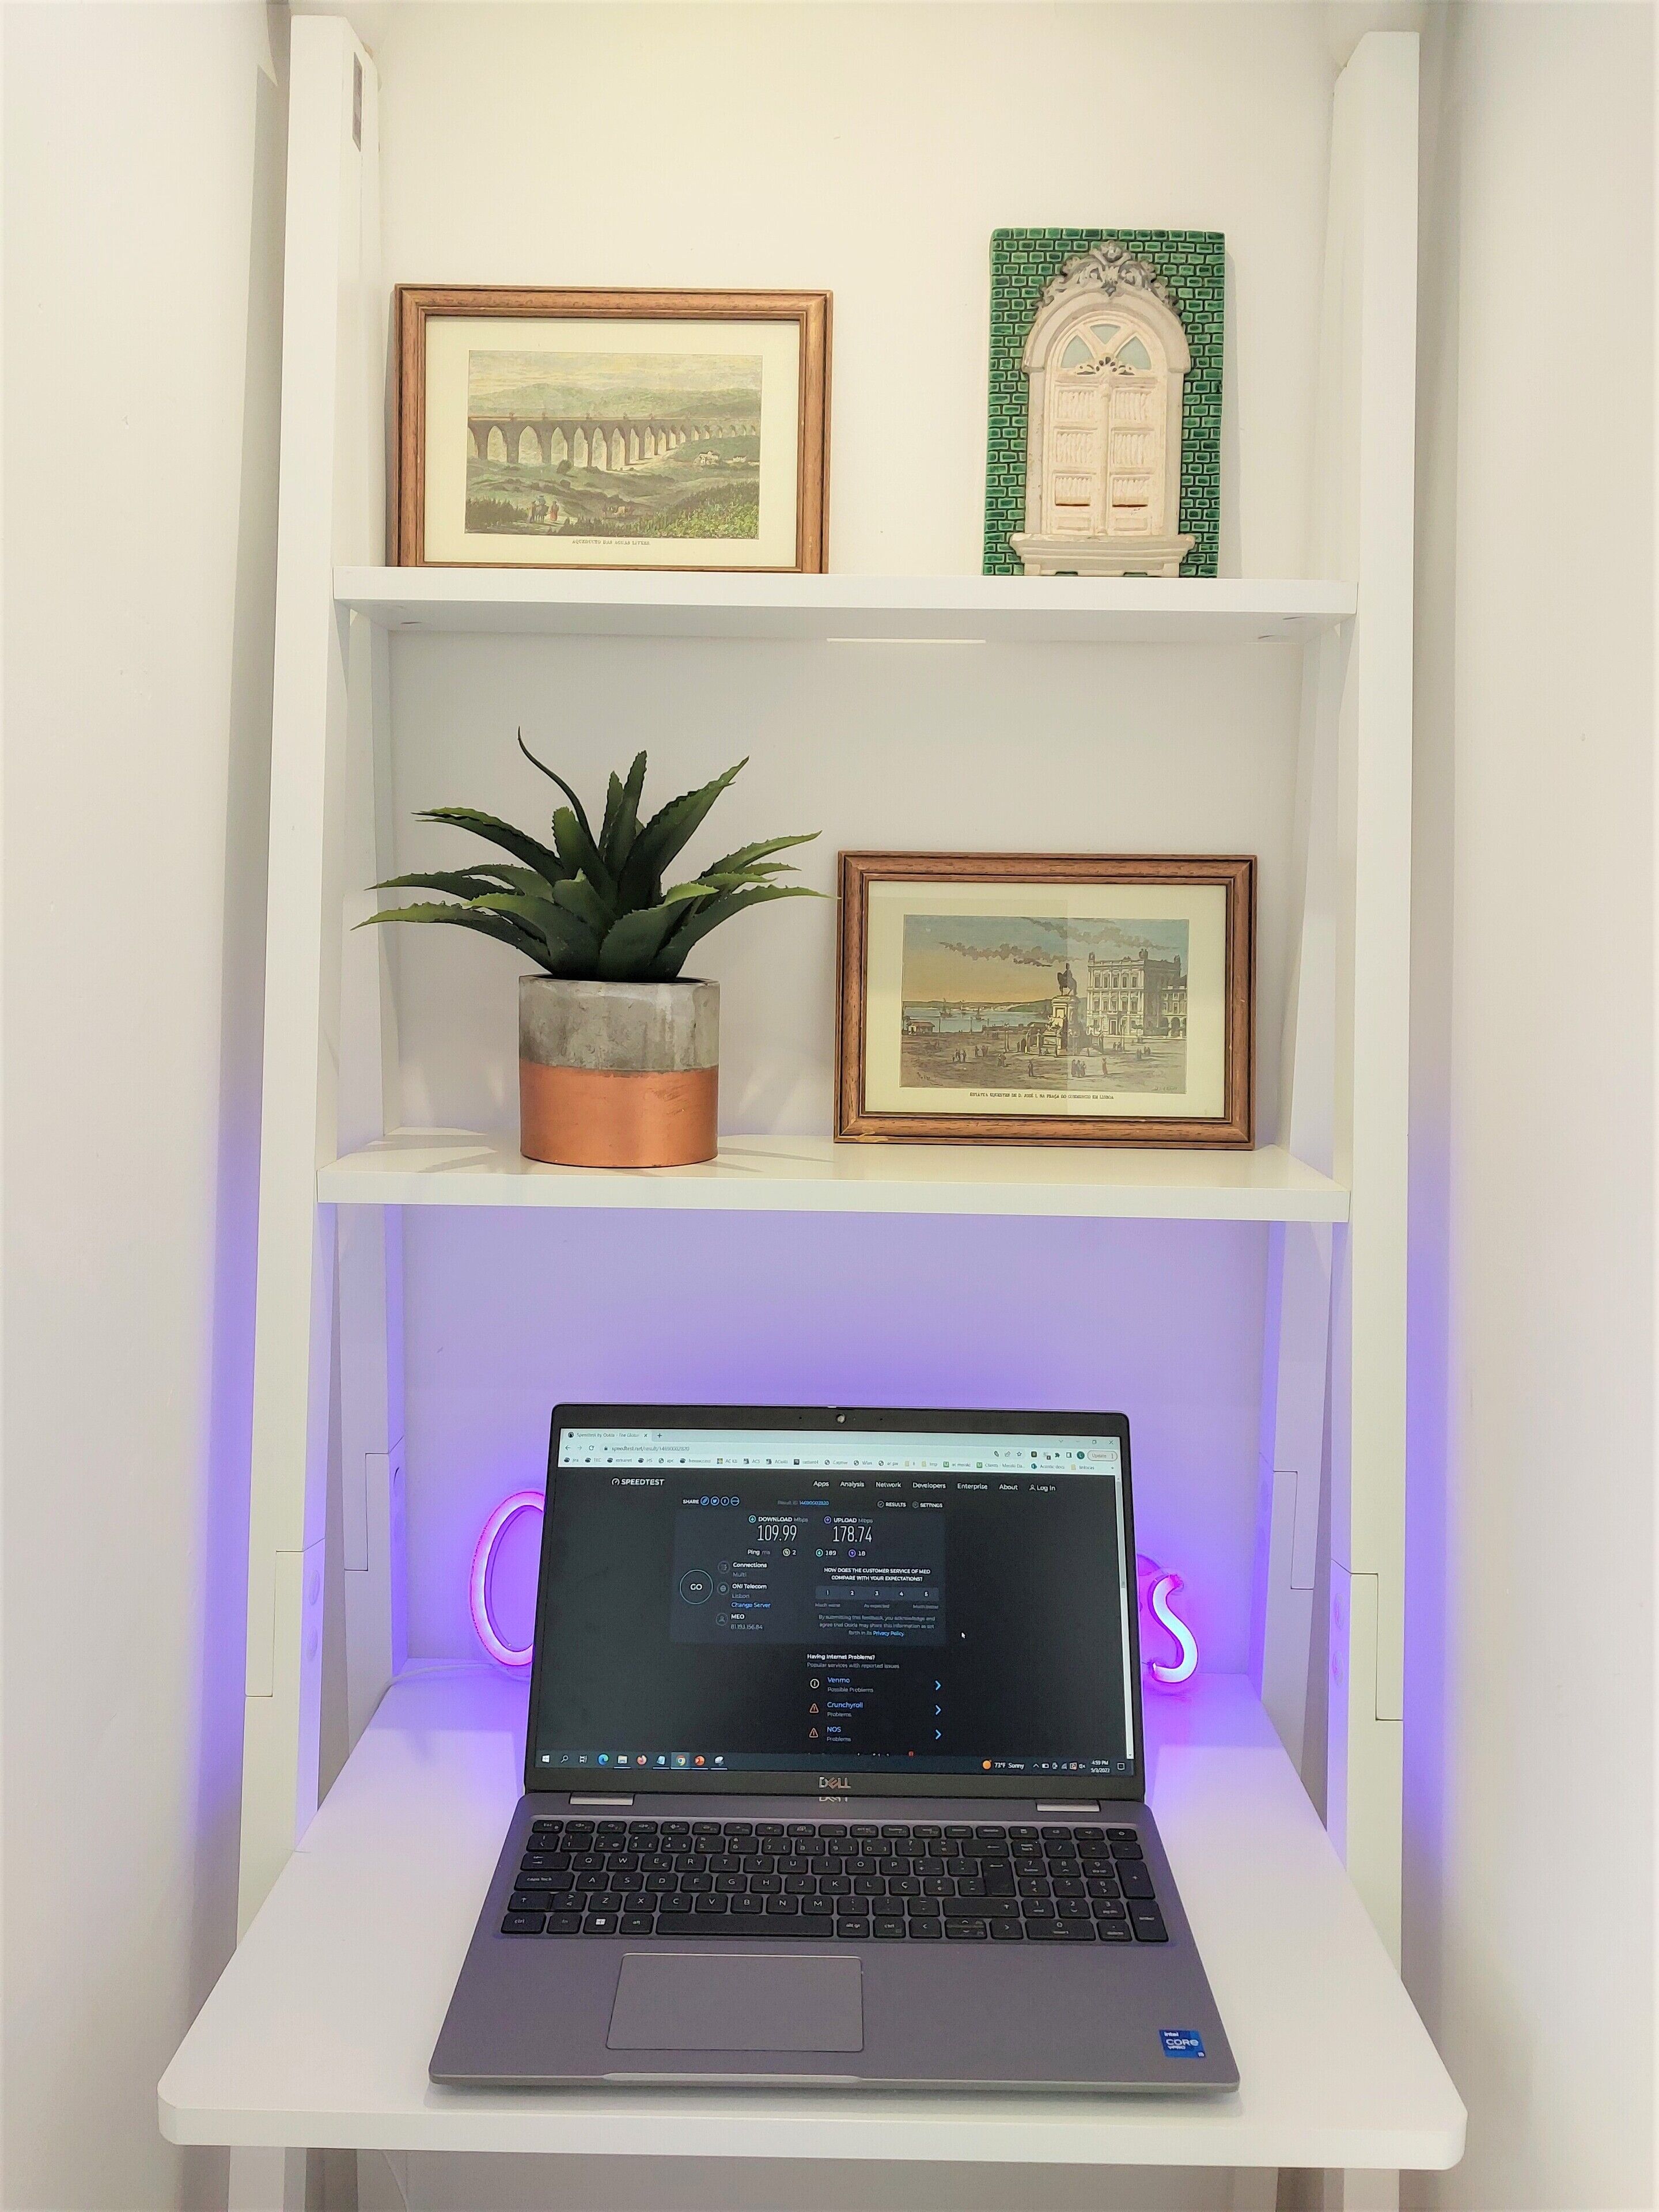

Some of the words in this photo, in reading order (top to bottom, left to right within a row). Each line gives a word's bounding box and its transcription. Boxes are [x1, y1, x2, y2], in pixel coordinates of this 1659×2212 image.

[757, 1524, 797, 1541] 109.99
[833, 1526, 872, 1543] 178.74
[819, 1777, 851, 1789] DELL
